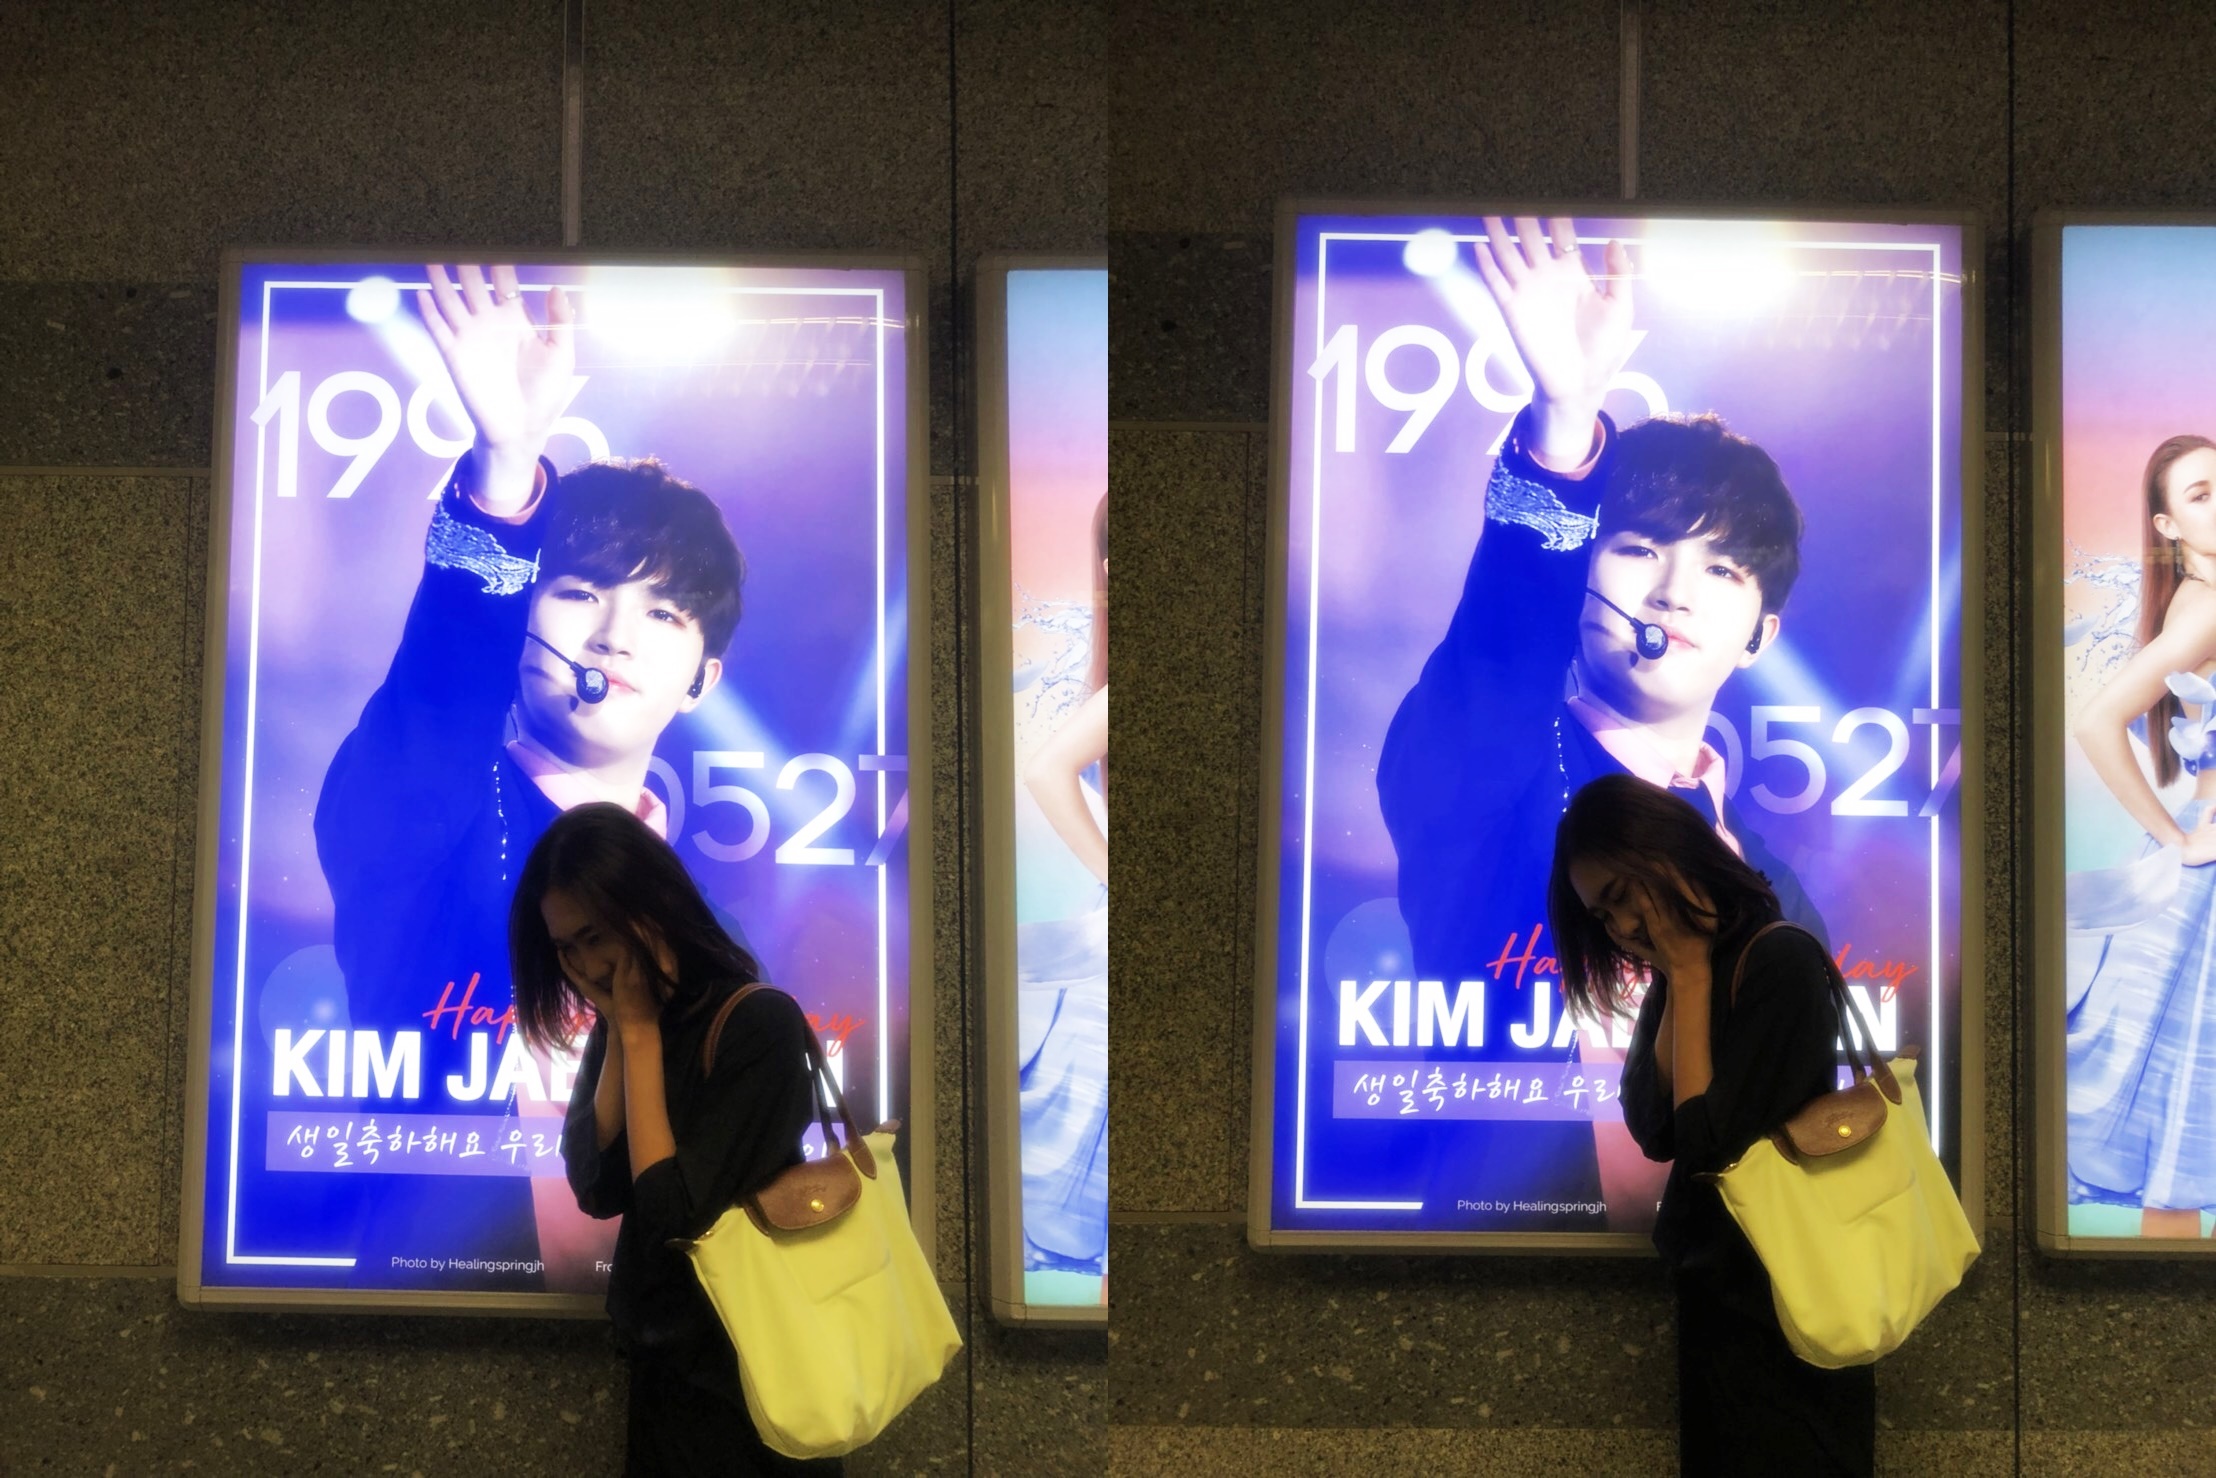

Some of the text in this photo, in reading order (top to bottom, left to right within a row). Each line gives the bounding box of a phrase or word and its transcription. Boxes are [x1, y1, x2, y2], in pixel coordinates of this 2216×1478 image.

[1338, 980, 1485, 1048] KIM
[273, 1029, 421, 1099] KIM
[1353, 1066, 1549, 1115] 생일축하해요
[286, 1118, 563, 1168] 생일축하해요 우리
[1457, 1199, 1607, 1215] Photo by Healingspringjh
[391, 1256, 545, 1274] Photo by Healingspringjh
